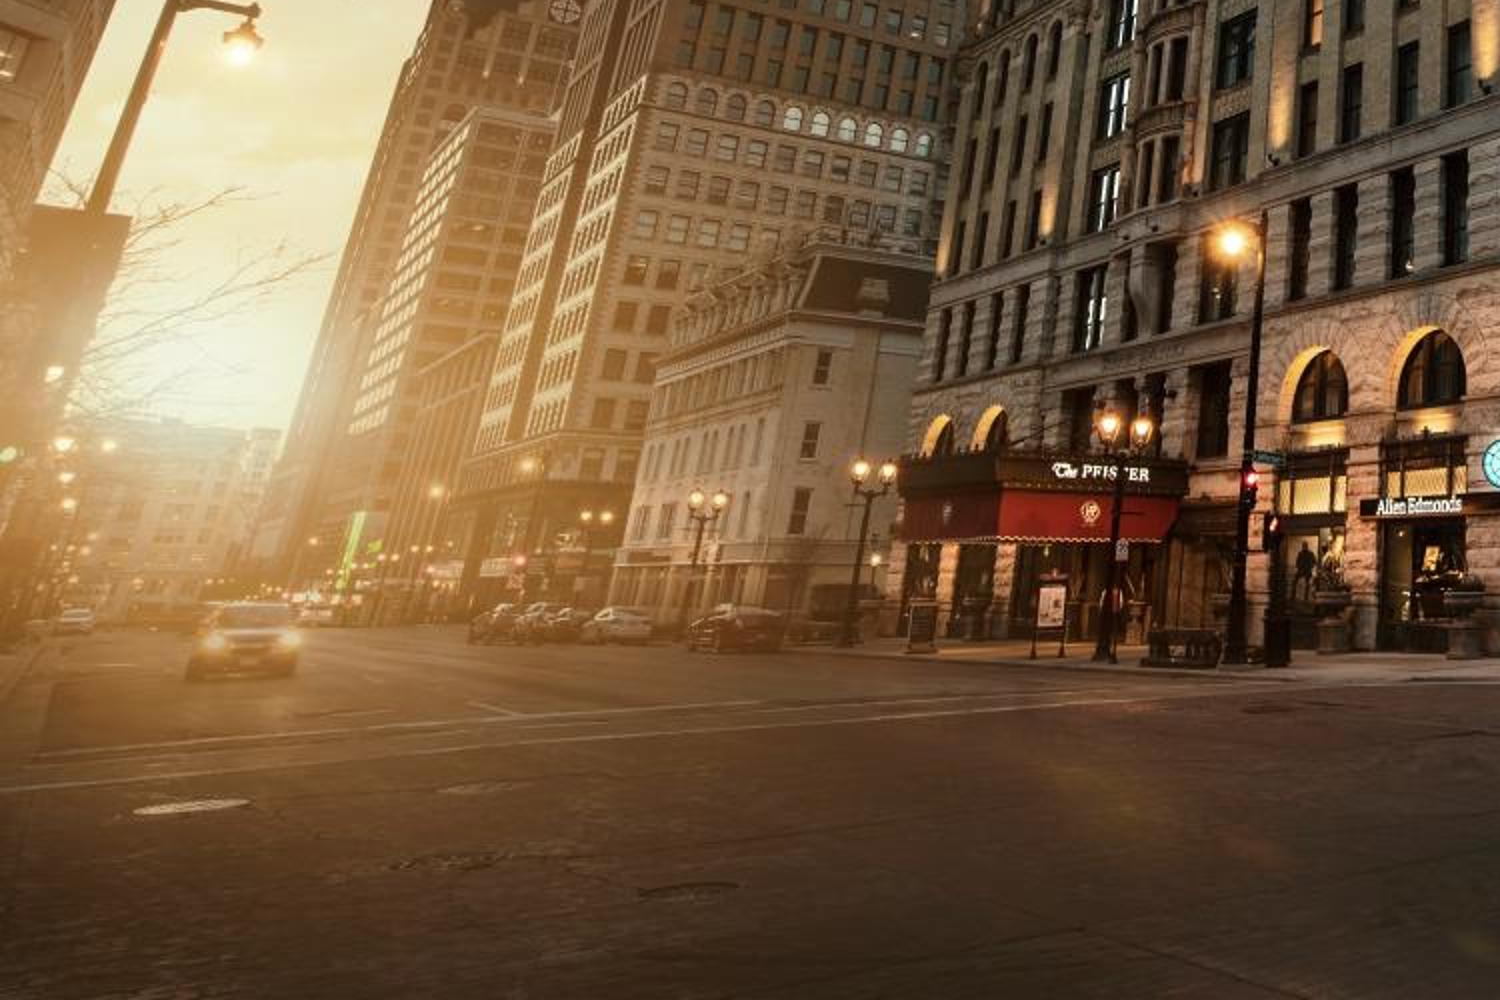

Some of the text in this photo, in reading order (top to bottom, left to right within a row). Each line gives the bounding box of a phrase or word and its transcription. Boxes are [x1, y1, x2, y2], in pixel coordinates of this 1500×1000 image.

[1081, 464, 1150, 482] PFISER
[1376, 496, 1463, 514] Allen Edmonds
